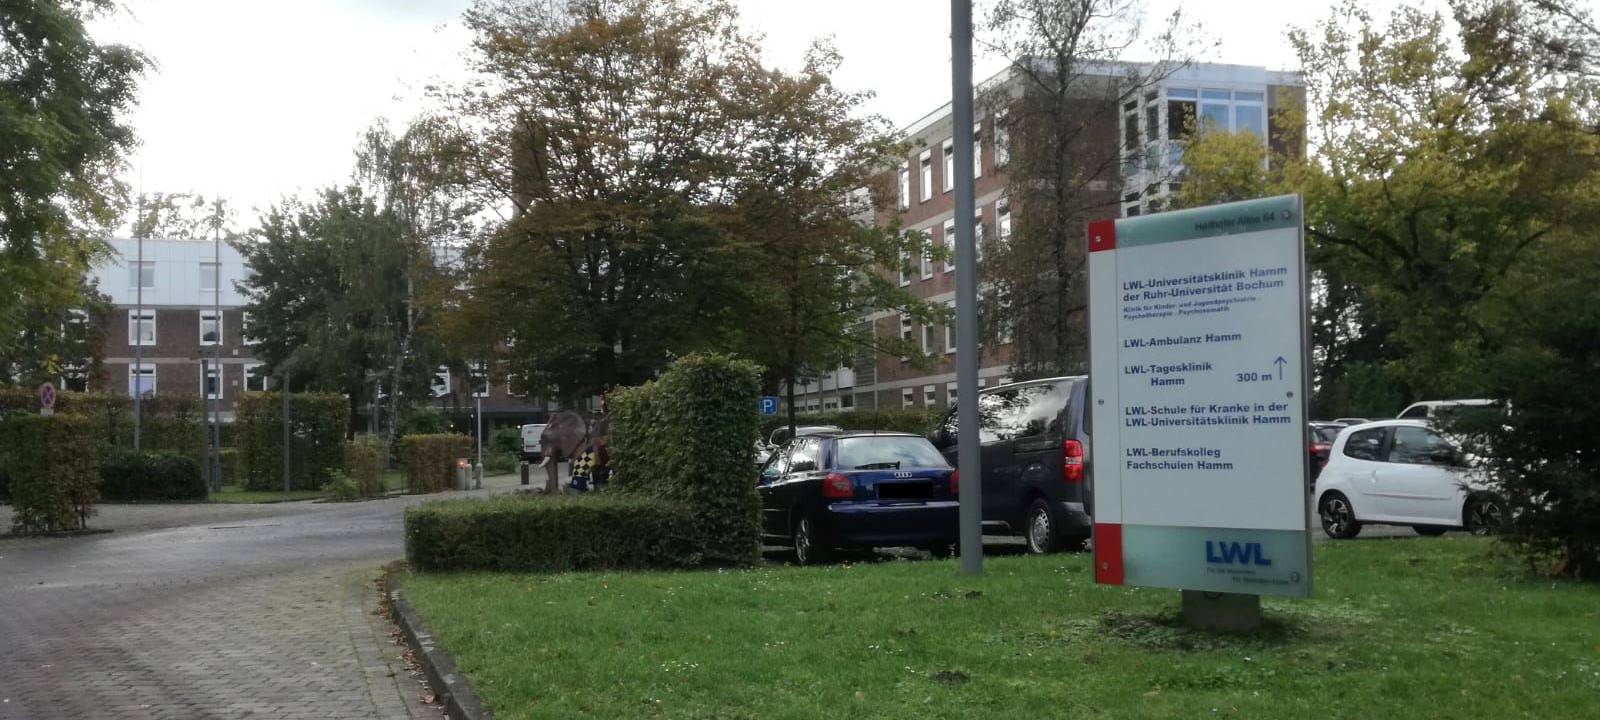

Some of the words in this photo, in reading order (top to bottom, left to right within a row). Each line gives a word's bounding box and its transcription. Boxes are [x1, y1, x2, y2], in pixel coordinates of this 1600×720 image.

[1123, 269, 1246, 291] LWL-Universitätsklinik
[1249, 267, 1287, 278] Hamm
[1123, 293, 1140, 302] der
[1143, 283, 1233, 301] Ruhr-Universität
[1236, 280, 1284, 291] Bochum
[1124, 335, 1202, 348] LWL-Ambulanz
[1205, 333, 1242, 343] Hamm
[1124, 361, 1213, 375] LWL-Tagesklinik
[1150, 376, 1186, 387] Hamm
[1236, 372, 1258, 382] 300
[1261, 373, 1273, 381] m
[763, 399, 773, 413] P
[1125, 405, 1187, 416] LWL-Schule
[1190, 403, 1206, 414] für
[1208, 403, 1250, 413] Kranke
[1253, 402, 1265, 412] in
[1267, 402, 1289, 412] der
[1125, 415, 1250, 427] LWL-Universitätsklinik
[1252, 414, 1292, 424] Hamm
[1126, 448, 1221, 459] LWL-Berufskolleg
[1126, 460, 1194, 470] Fachschulen
[1198, 461, 1234, 470] Hamm
[1205, 541, 1272, 567] LWL
